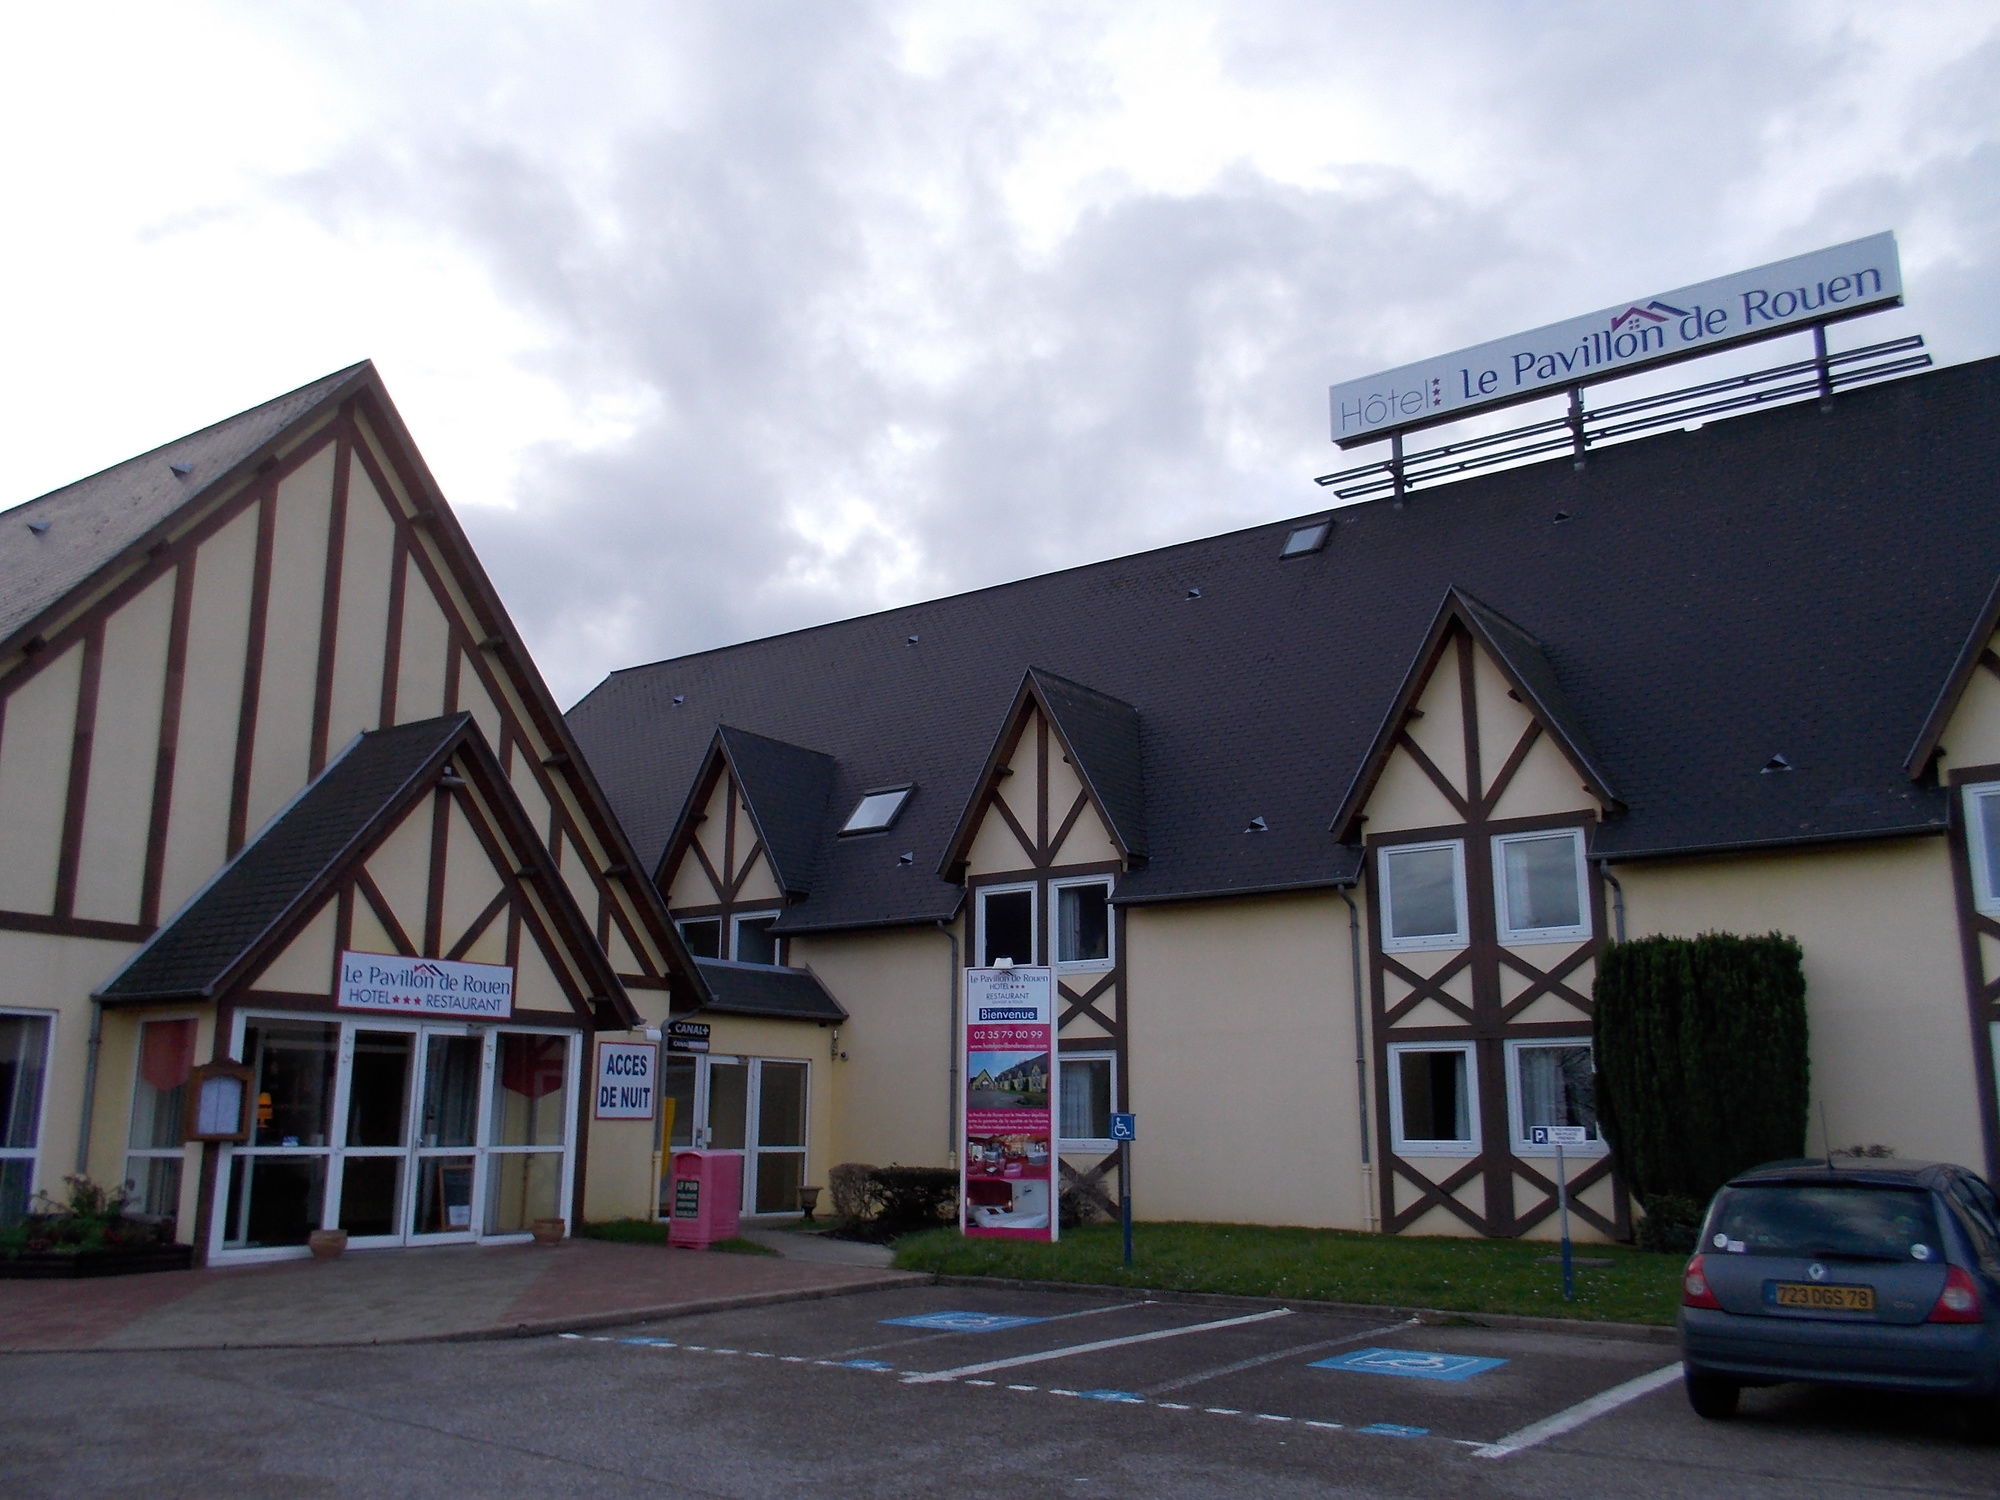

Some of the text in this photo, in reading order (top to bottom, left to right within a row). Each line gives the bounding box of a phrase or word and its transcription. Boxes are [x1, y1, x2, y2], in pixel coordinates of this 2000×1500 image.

[1341, 267, 1882, 431] Hôtel Le Pavillon de Rouen
[345, 964, 511, 996] Le Pavillon de Rouen
[970, 973, 1049, 983] Le Pavillon de Rouen
[350, 988, 503, 1012] HOTEL RESTAURANT
[985, 992, 1030, 1000] RESTAURANT
[981, 1009, 1035, 1020] Bienvenue
[675, 1023, 709, 1035] CANAL+
[973, 1030, 1043, 1039] 02 35 79 00 99
[606, 1054, 648, 1076] ACCES
[600, 1086, 651, 1108] DE NUIT
[1535, 1130, 1544, 1143] P
[1777, 1286, 1869, 1308] 723 DGS 78
